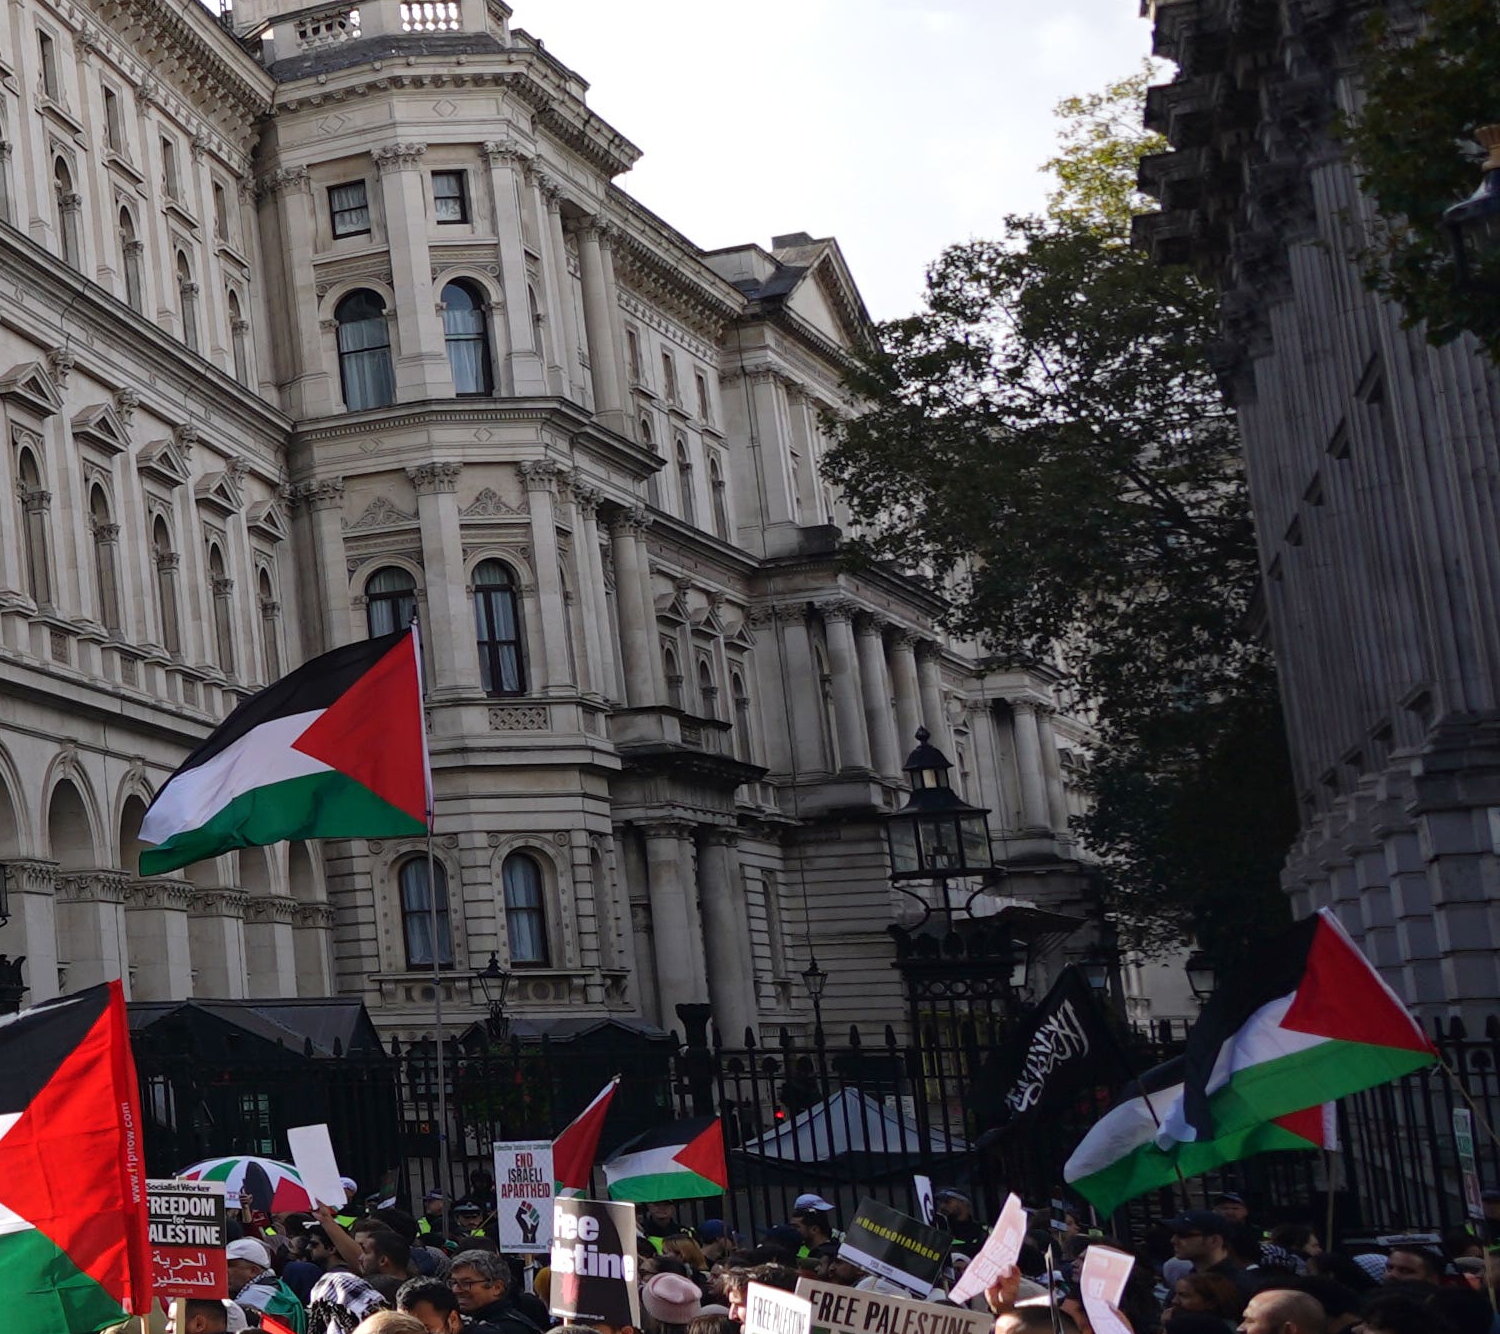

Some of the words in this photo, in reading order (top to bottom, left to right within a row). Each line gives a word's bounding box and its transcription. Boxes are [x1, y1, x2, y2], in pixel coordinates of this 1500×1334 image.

[515, 1152, 534, 1168] END
[508, 1167, 543, 1184] ISRAELI
[501, 1182, 551, 1199] APARTHEID
[172, 1214, 186, 1225] for
[148, 1224, 222, 1245] ALESTINE
[751, 1294, 773, 1333] FREE
[809, 1288, 862, 1330] FREE
